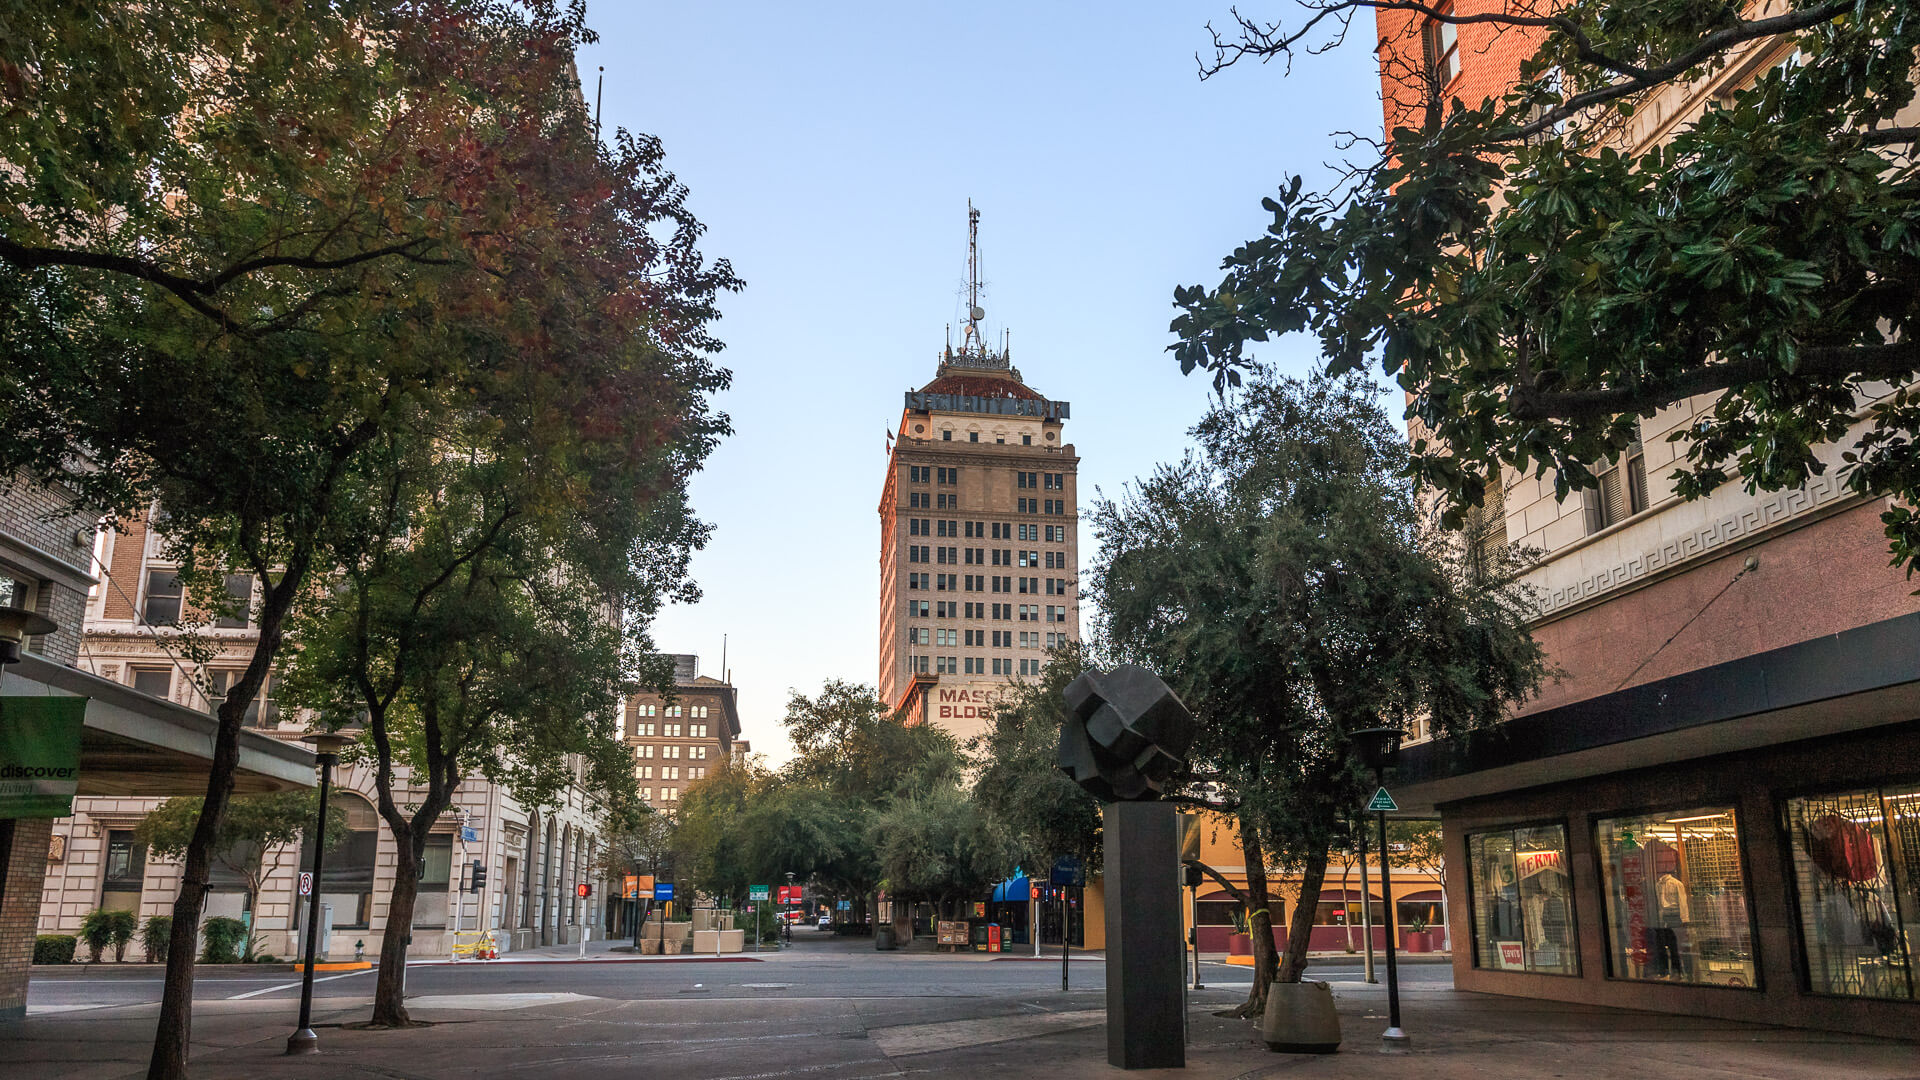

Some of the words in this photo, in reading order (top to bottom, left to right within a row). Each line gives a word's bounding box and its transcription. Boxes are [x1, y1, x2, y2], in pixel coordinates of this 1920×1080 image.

[910, 393, 1006, 414] SECURITY
[1015, 399, 1065, 419] BANK
[1, 763, 76, 778] discover
